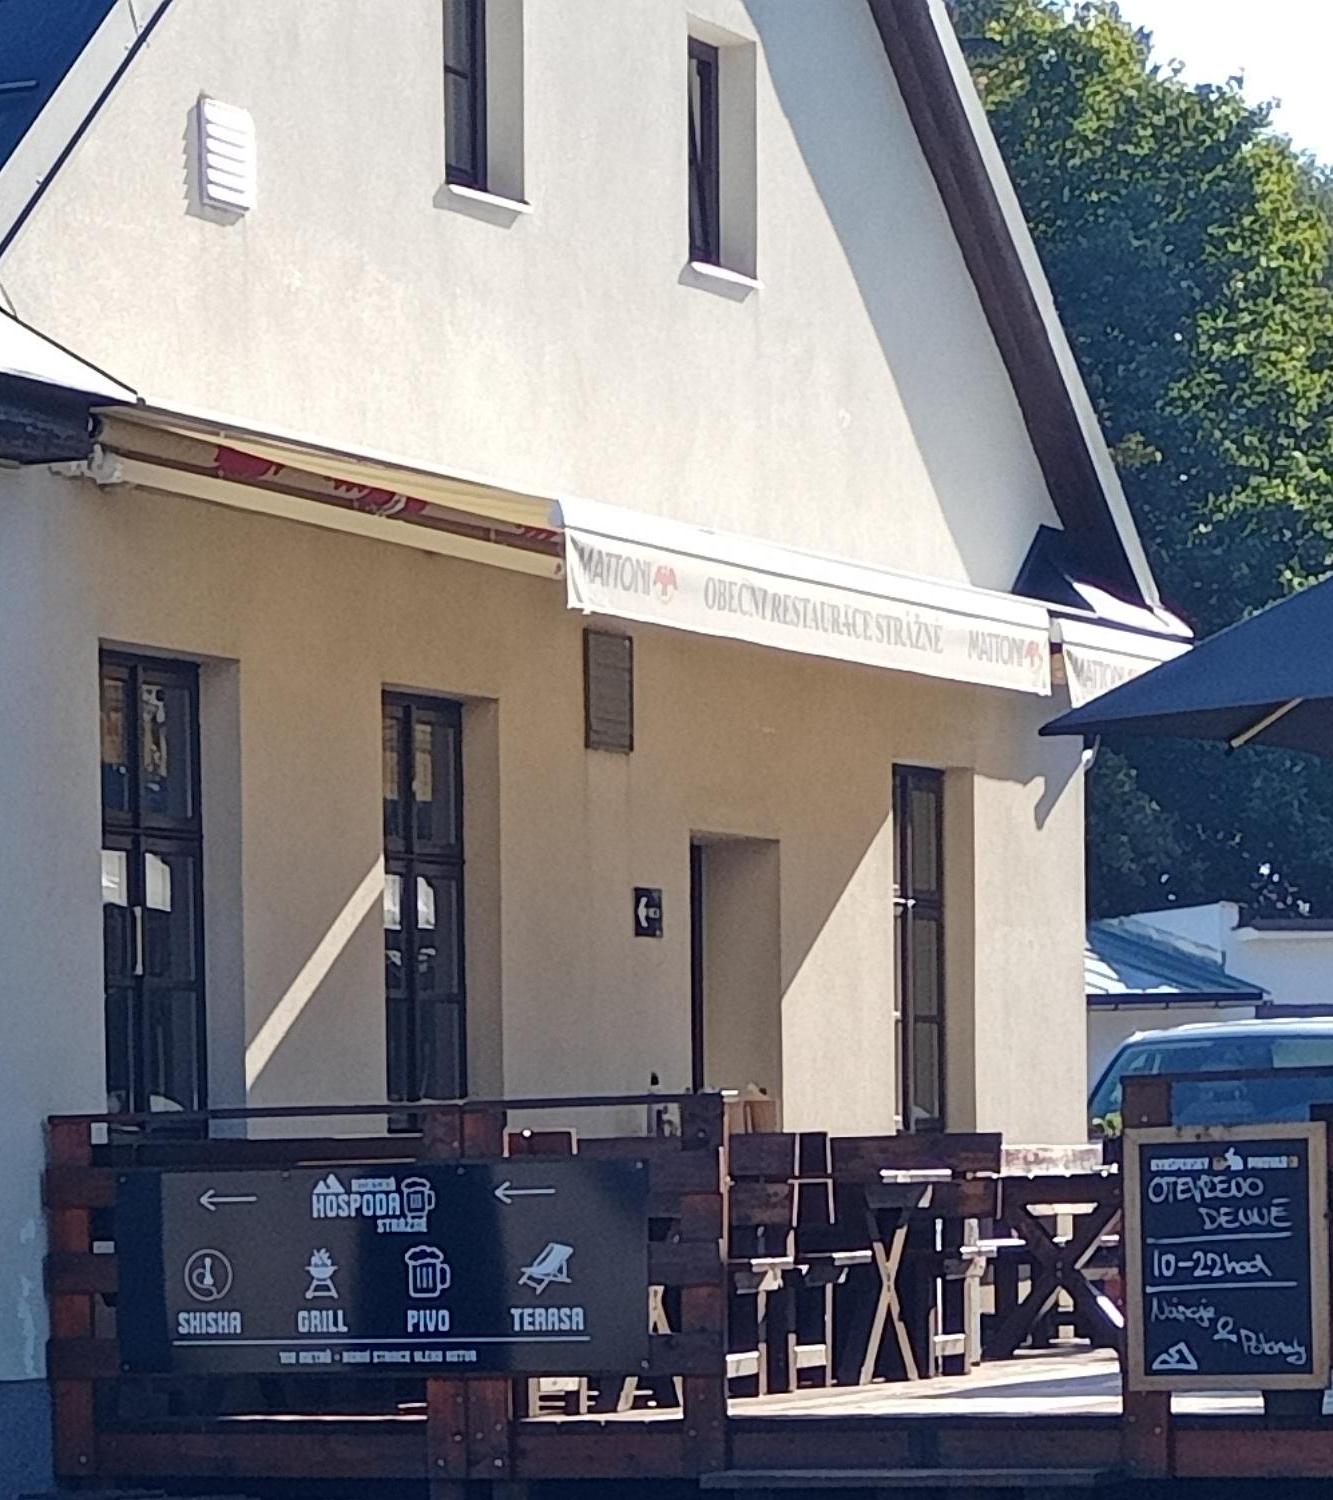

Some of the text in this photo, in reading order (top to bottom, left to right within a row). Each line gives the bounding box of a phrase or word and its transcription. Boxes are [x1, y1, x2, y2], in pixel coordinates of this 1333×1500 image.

[580, 543, 652, 596] MATTONI
[312, 1192, 401, 1218] HOSPODA
[178, 1311, 242, 1334] SHISHA
[297, 1309, 349, 1333] GRILL
[407, 1309, 450, 1333] PIVO
[510, 1307, 585, 1331] TERASA
